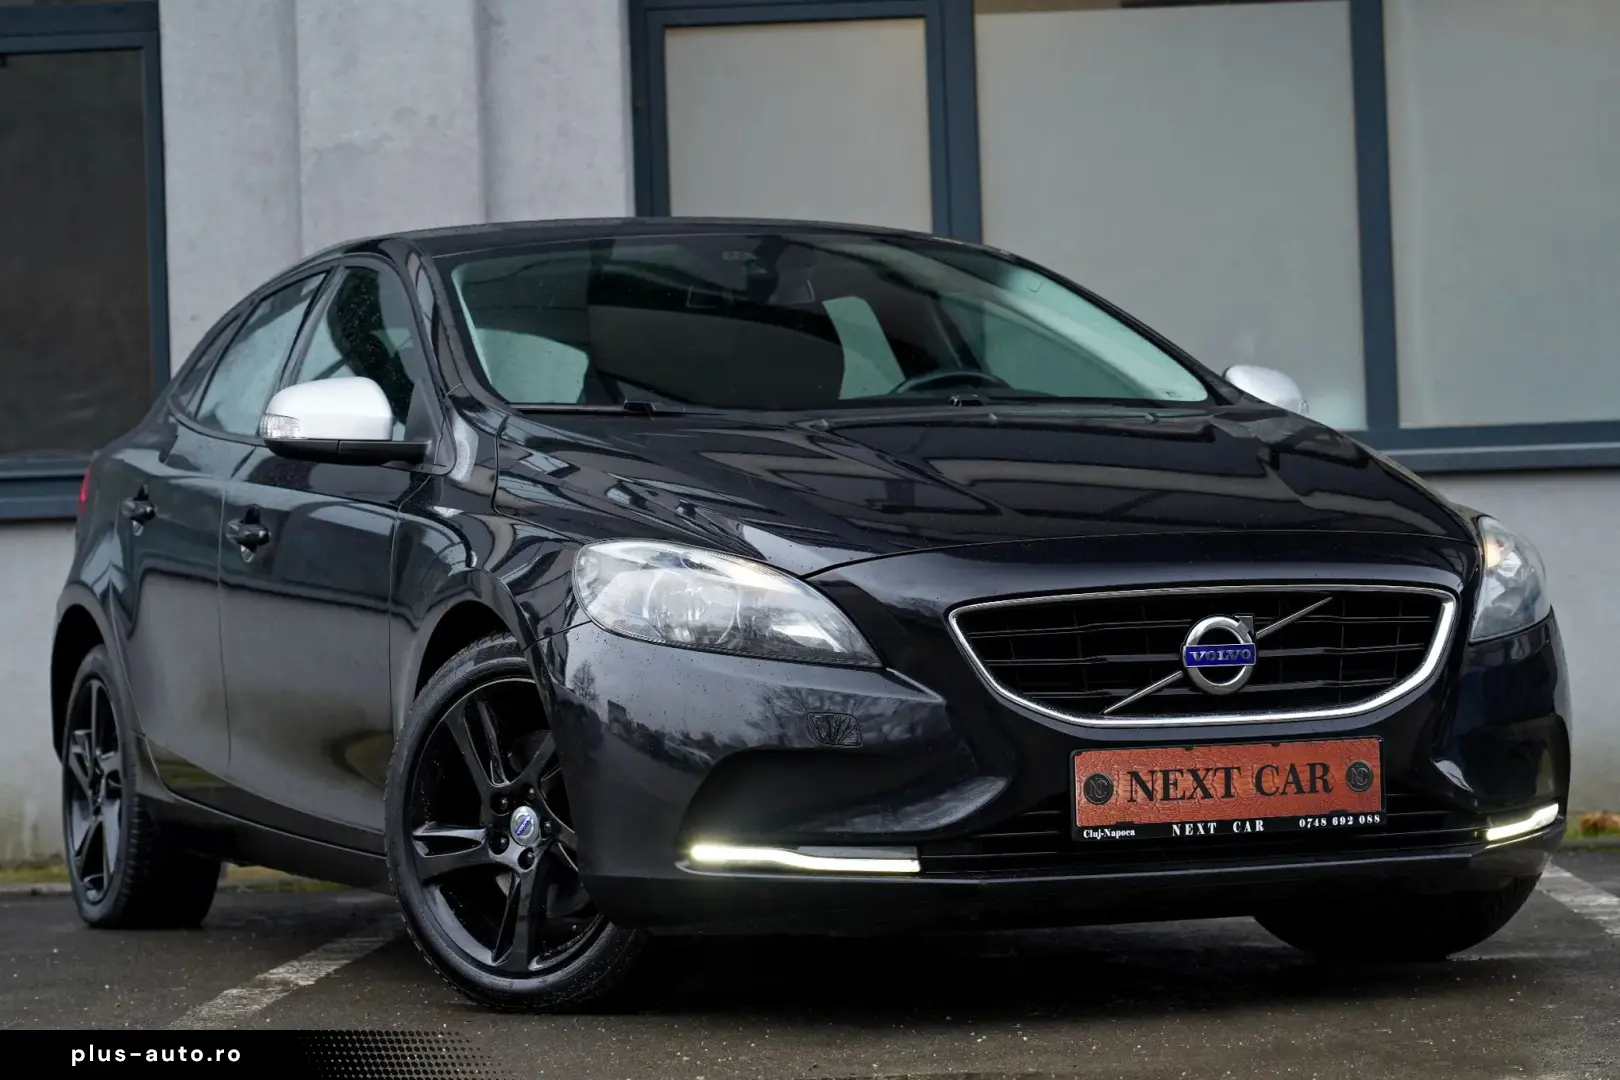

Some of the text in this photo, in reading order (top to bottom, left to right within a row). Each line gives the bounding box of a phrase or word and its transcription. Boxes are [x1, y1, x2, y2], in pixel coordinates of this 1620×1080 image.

[1189, 648, 1252, 662] VOLVO
[1126, 762, 1334, 803] NEXT CAR
[1172, 819, 1265, 836] NEXT CAR
[1299, 814, 1381, 829] 0748 692 088
[1083, 827, 1136, 840] Cluj-Napoca
